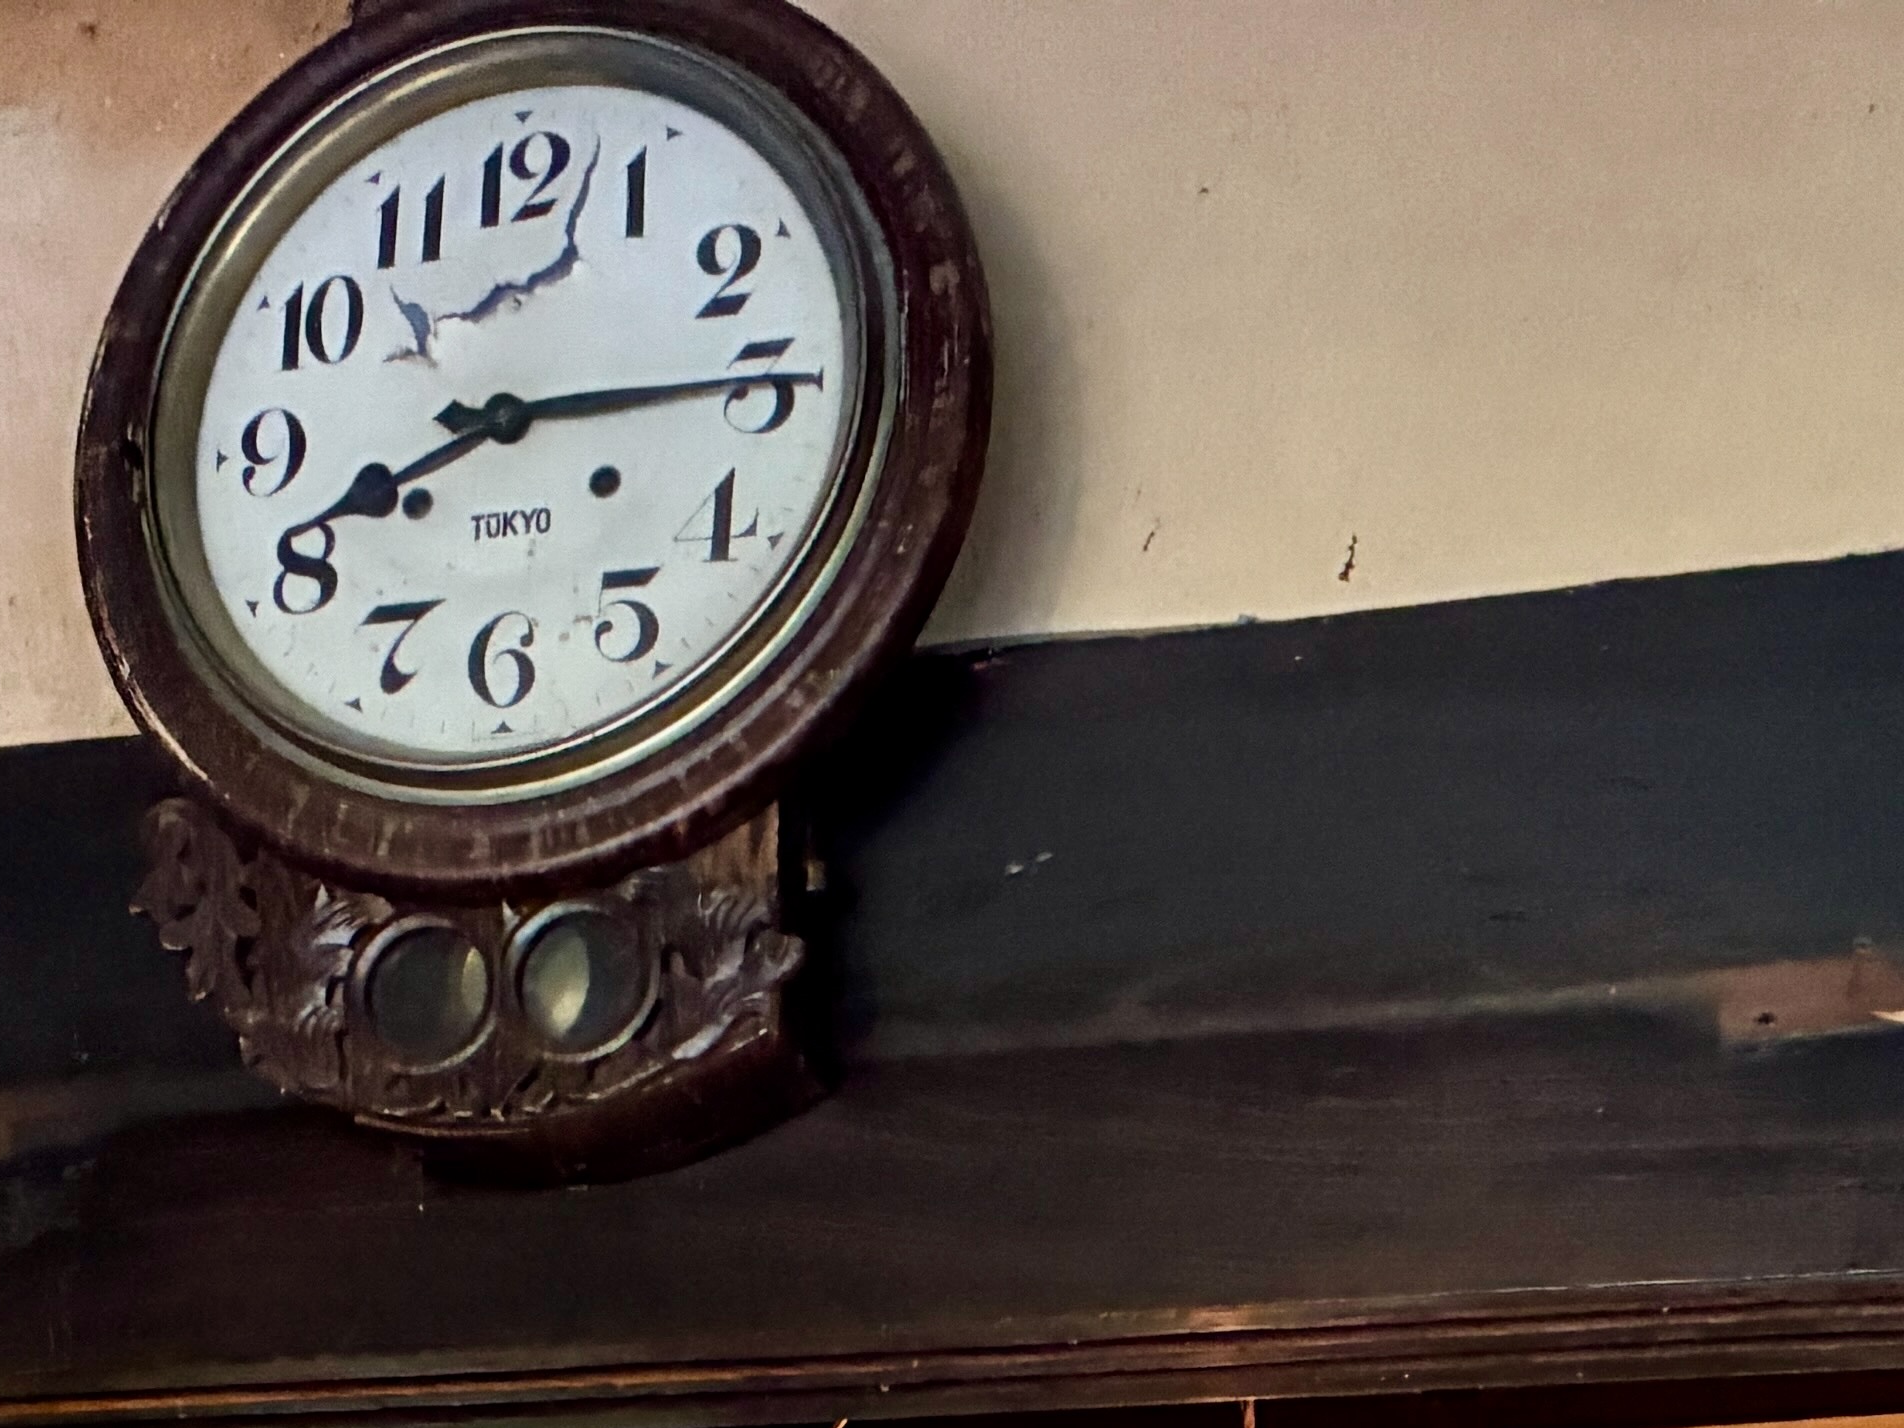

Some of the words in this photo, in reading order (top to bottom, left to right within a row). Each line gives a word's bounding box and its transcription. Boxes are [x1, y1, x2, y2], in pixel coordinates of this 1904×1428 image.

[375, 173, 447, 270] 11
[480, 130, 570, 229] 12
[624, 144, 652, 239] 1
[695, 223, 762, 319] 2
[278, 274, 365, 371] 10
[722, 337, 796, 433] 3
[240, 408, 306, 497] 9
[672, 466, 760, 564] 4
[272, 519, 338, 615] 8
[593, 565, 663, 663] 5
[362, 599, 446, 694] 7
[468, 611, 536, 707] 6
